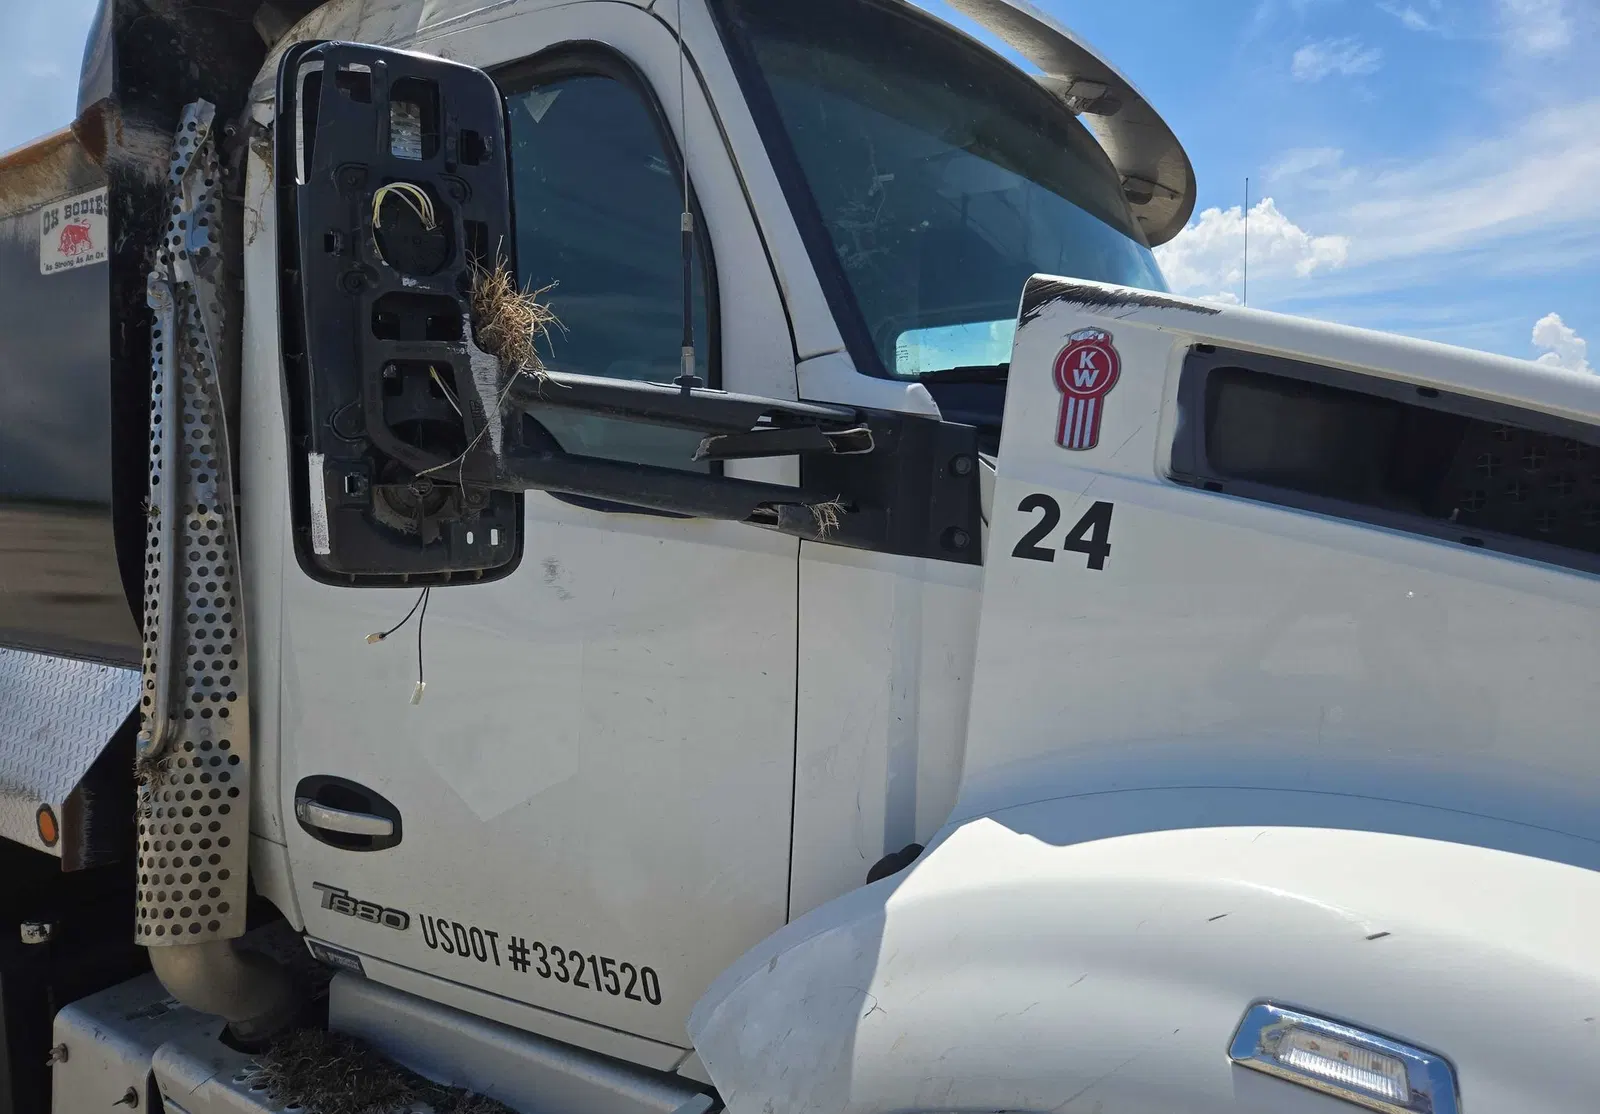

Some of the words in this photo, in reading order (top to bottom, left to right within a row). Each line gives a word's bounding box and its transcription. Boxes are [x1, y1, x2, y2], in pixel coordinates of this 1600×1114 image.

[43, 208, 59, 235] OX
[55, 260, 74, 270] Strong
[1011, 493, 1114, 571] 24
[312, 881, 410, 930] T880
[419, 913, 501, 966] USDOT
[507, 935, 662, 1006] #3321520
